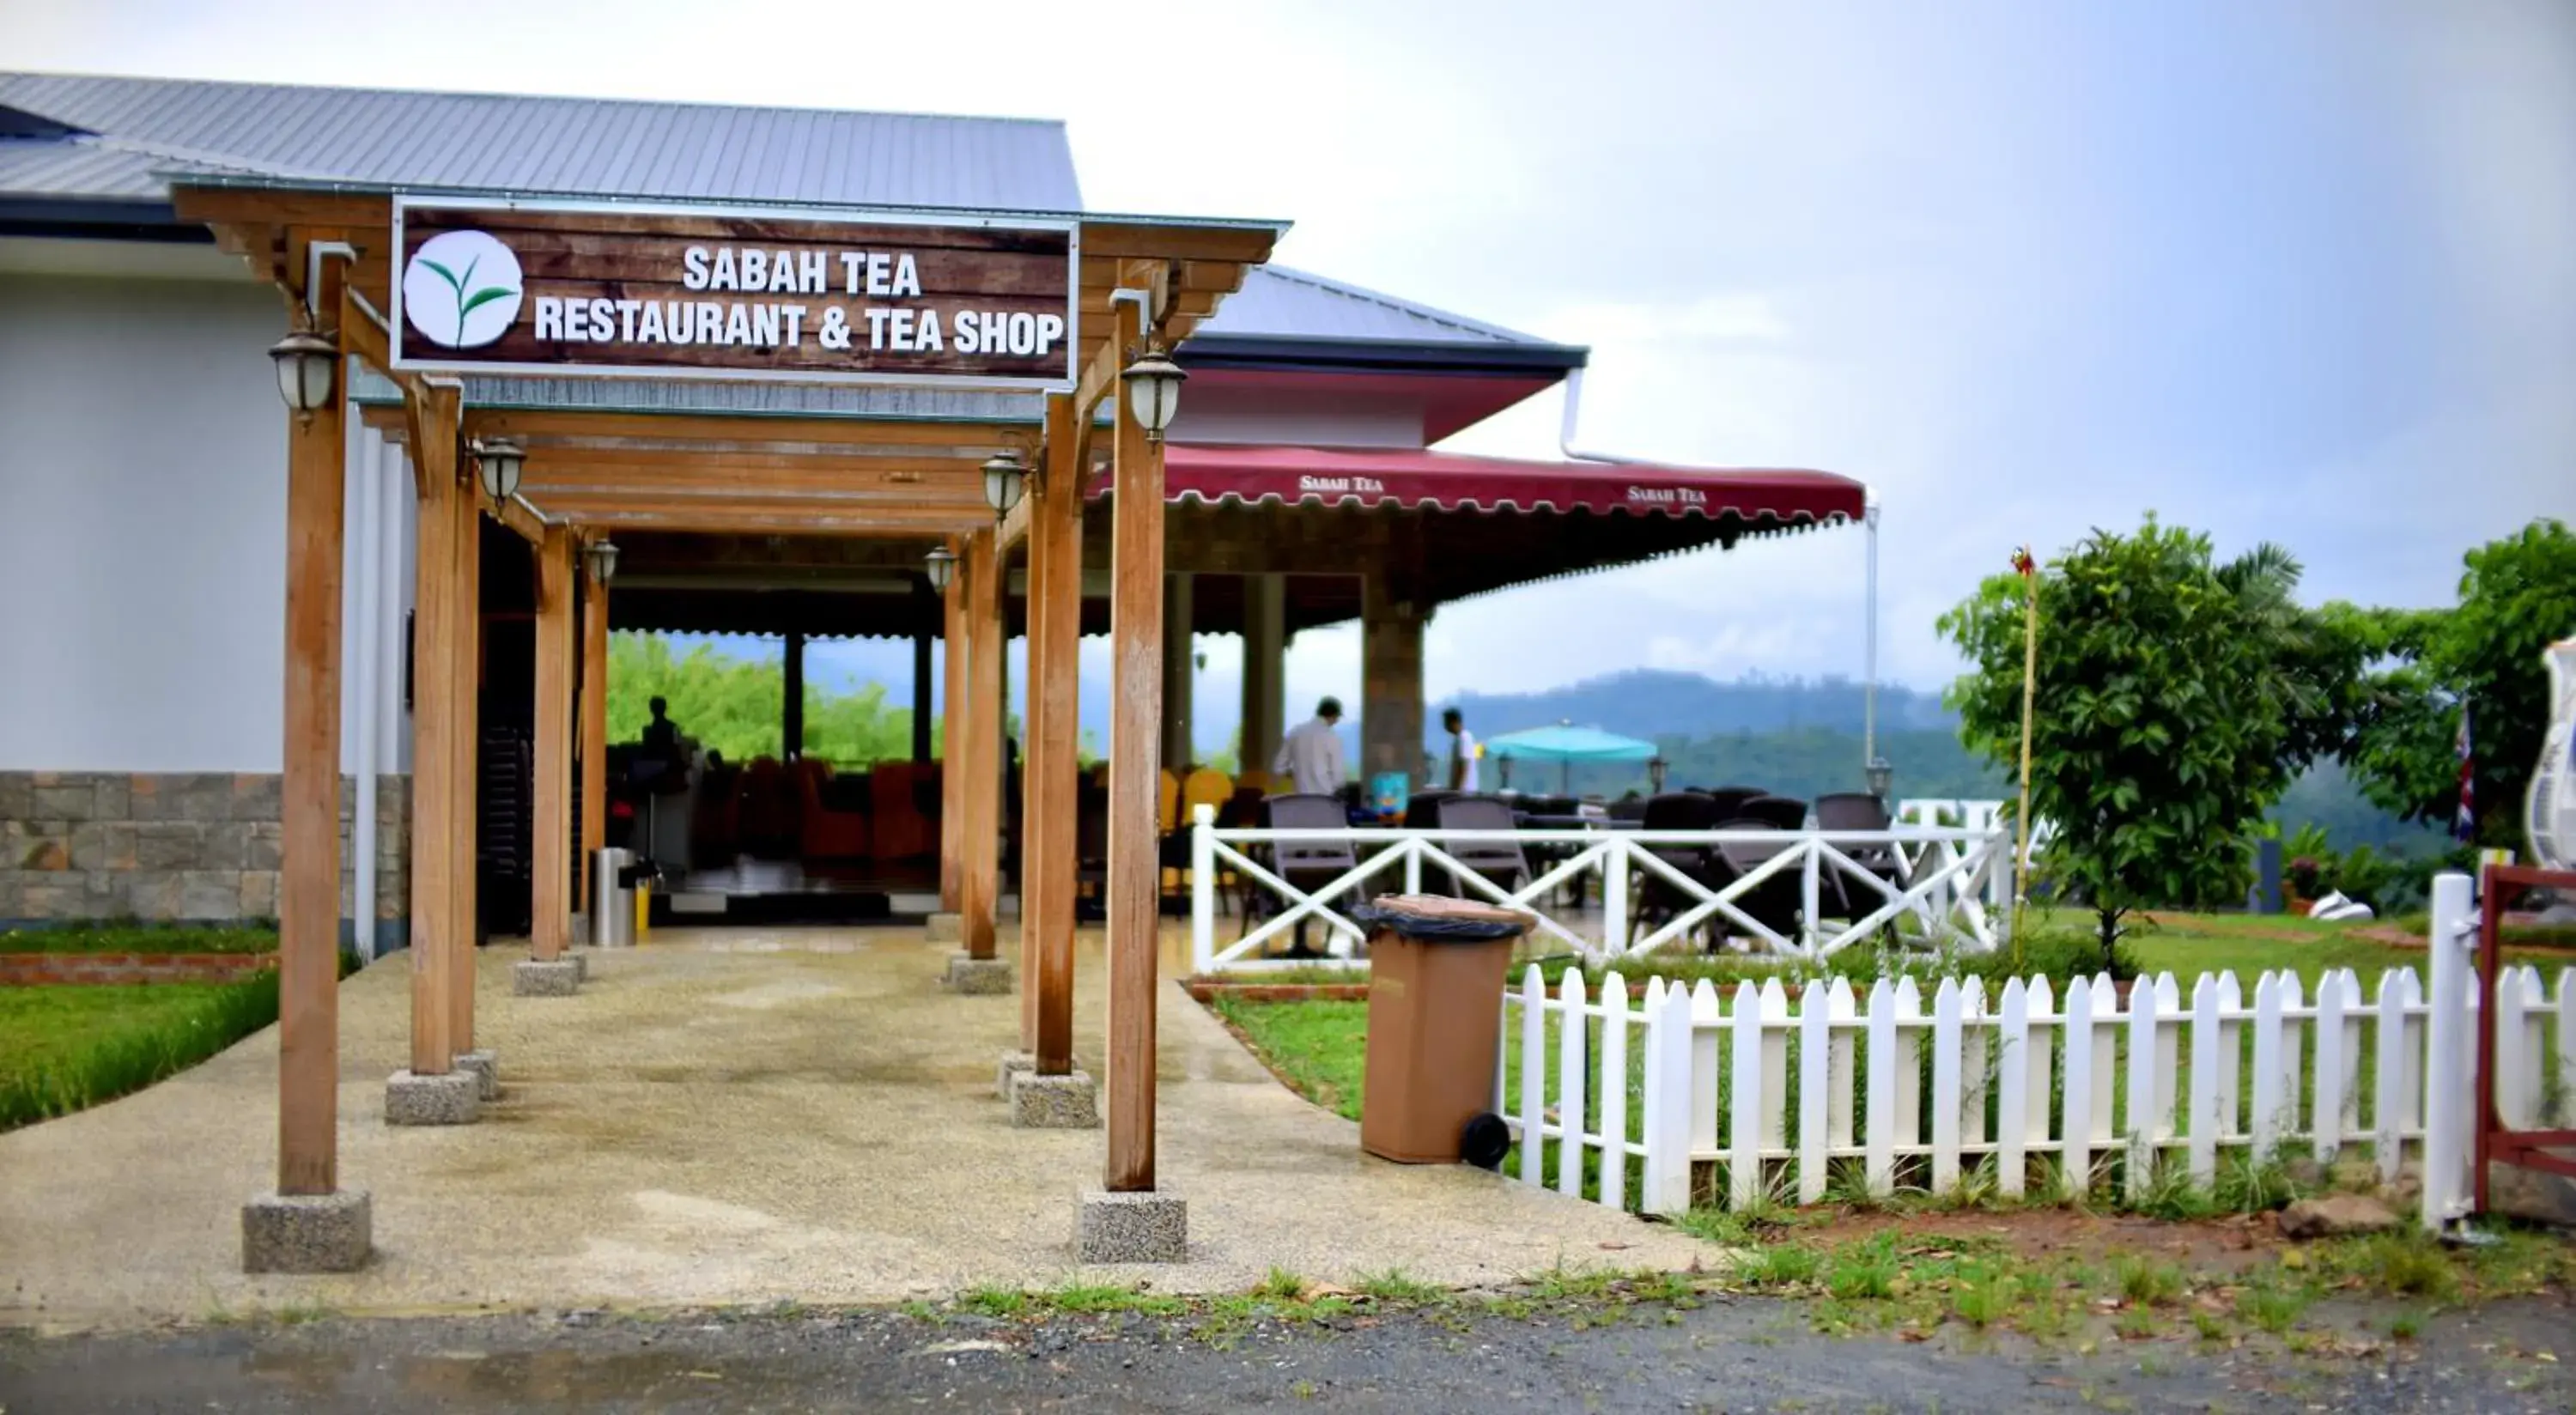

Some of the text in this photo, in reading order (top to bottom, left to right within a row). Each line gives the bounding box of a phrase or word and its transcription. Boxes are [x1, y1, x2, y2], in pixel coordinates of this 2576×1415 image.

[683, 246, 921, 297] SABAH TEA
[534, 297, 1065, 356] RESTAURANT & TEA SHOP
[1352, 477, 1384, 492] TEA
[1677, 487, 1707, 502] TEA
